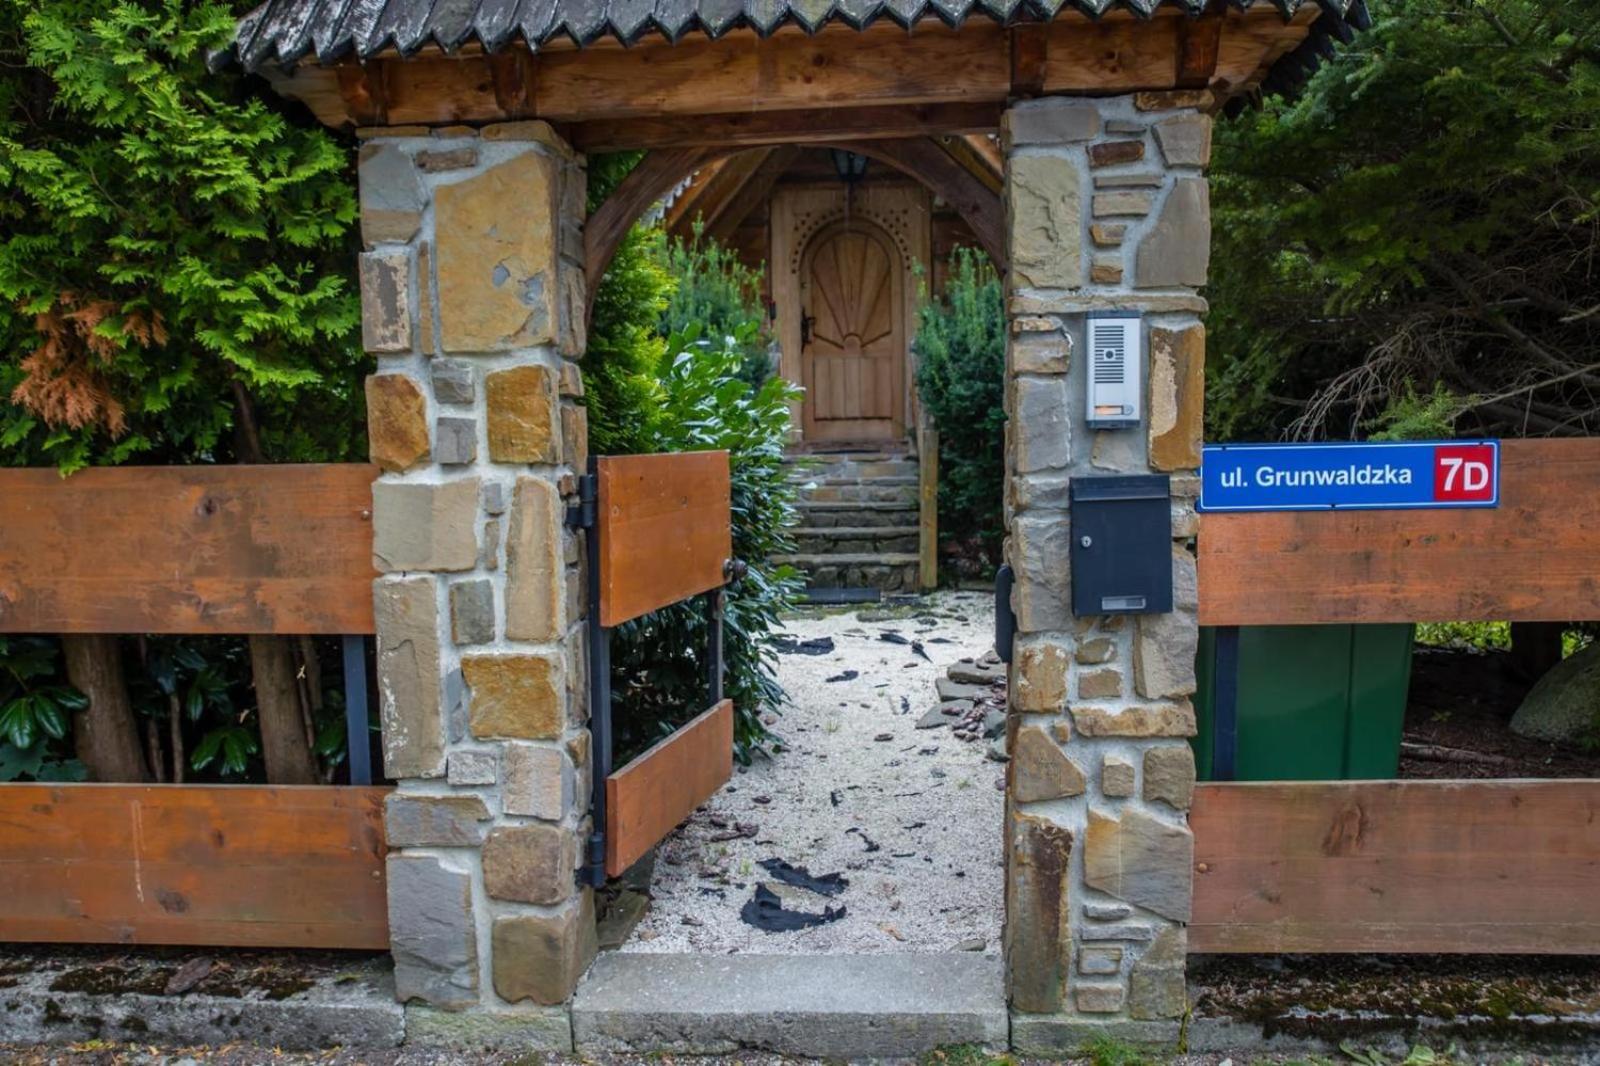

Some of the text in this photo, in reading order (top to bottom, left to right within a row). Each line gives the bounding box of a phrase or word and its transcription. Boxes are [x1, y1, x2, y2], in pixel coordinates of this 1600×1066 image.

[1220, 464, 1412, 487] ul. Grunwaldzka
[1440, 457, 1489, 492] 7D
